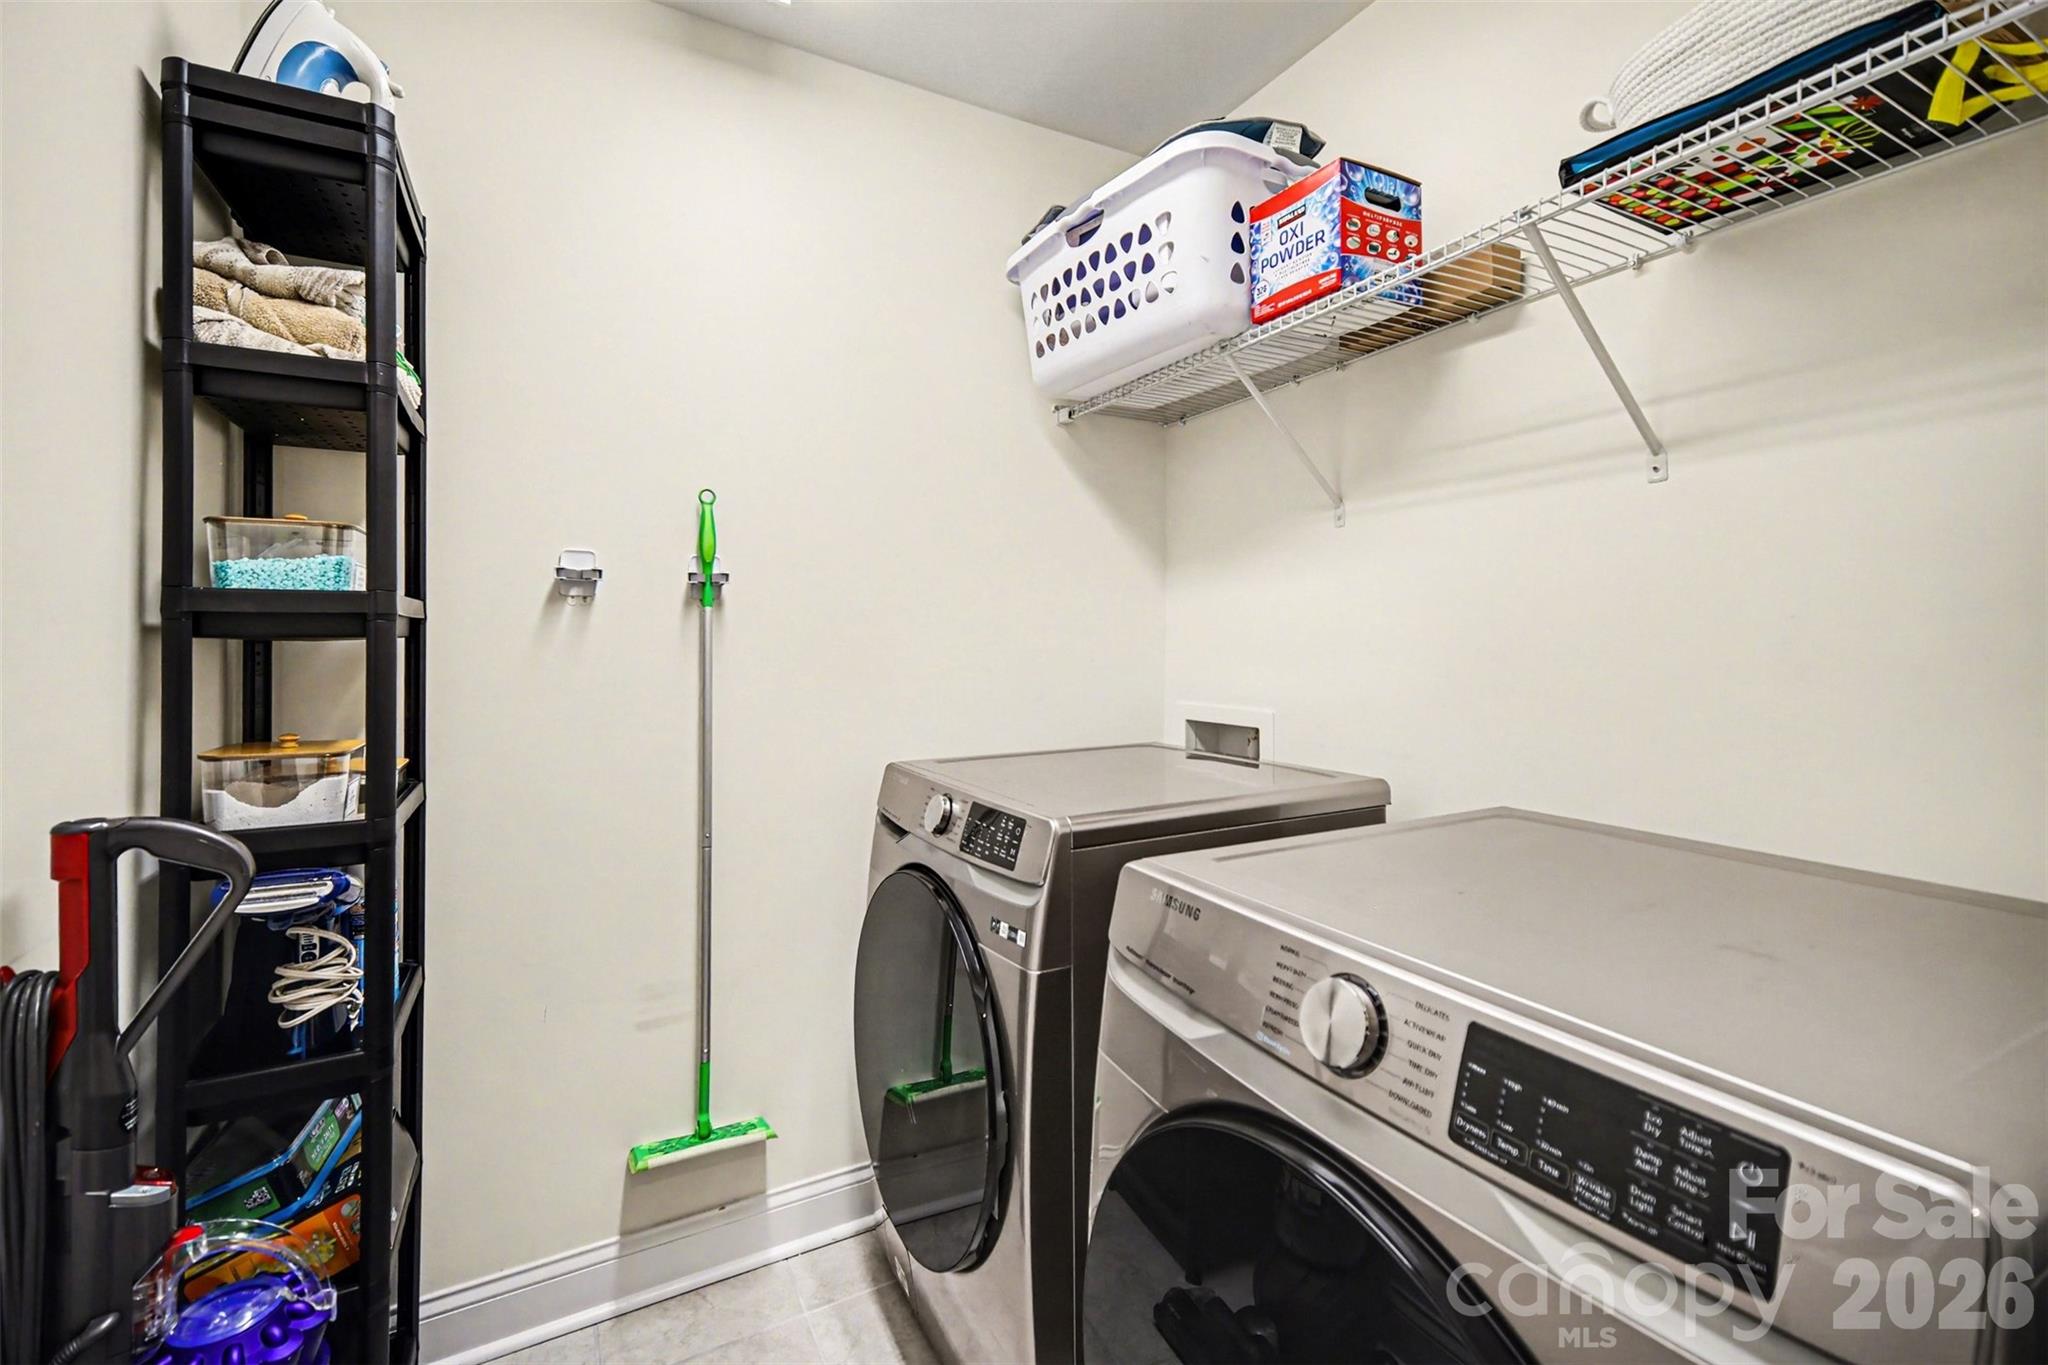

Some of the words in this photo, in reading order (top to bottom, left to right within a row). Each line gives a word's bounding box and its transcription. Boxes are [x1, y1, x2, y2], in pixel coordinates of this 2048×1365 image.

[1280, 221, 1304, 246] OXI
[1261, 230, 1325, 273] POWDER
[1150, 888, 1201, 921] SAMSUNG
[1415, 1001, 1450, 1021] DELICATES
[1404, 1018, 1446, 1041] ACTIVEWEAR
[1407, 1039, 1428, 1055] QUICK
[1428, 1049, 1442, 1061] DRY
[1408, 1059, 1423, 1073] TIME
[1424, 1067, 1438, 1079] DRY
[1388, 1089, 1432, 1119] DOWNLOADED
[1456, 1116, 1487, 1139] Dryness
[1643, 1121, 1662, 1138] Dry
[1680, 1126, 1712, 1147] Adjust
[1635, 1145, 1662, 1167] Damp
[1680, 1136, 1703, 1154] Time
[1538, 1159, 1560, 1178] Time
[1634, 1158, 1658, 1176] Alert
[1674, 1164, 1706, 1187] Adjust
[1577, 1174, 1611, 1200] Wrinkle
[1630, 1184, 1656, 1205] Drum
[1674, 1174, 1698, 1194] Time
[1575, 1184, 1610, 1208] Prevent
[1629, 1196, 1654, 1215] Light
[1670, 1203, 1703, 1227] Smart
[1667, 1214, 1705, 1241] Control
